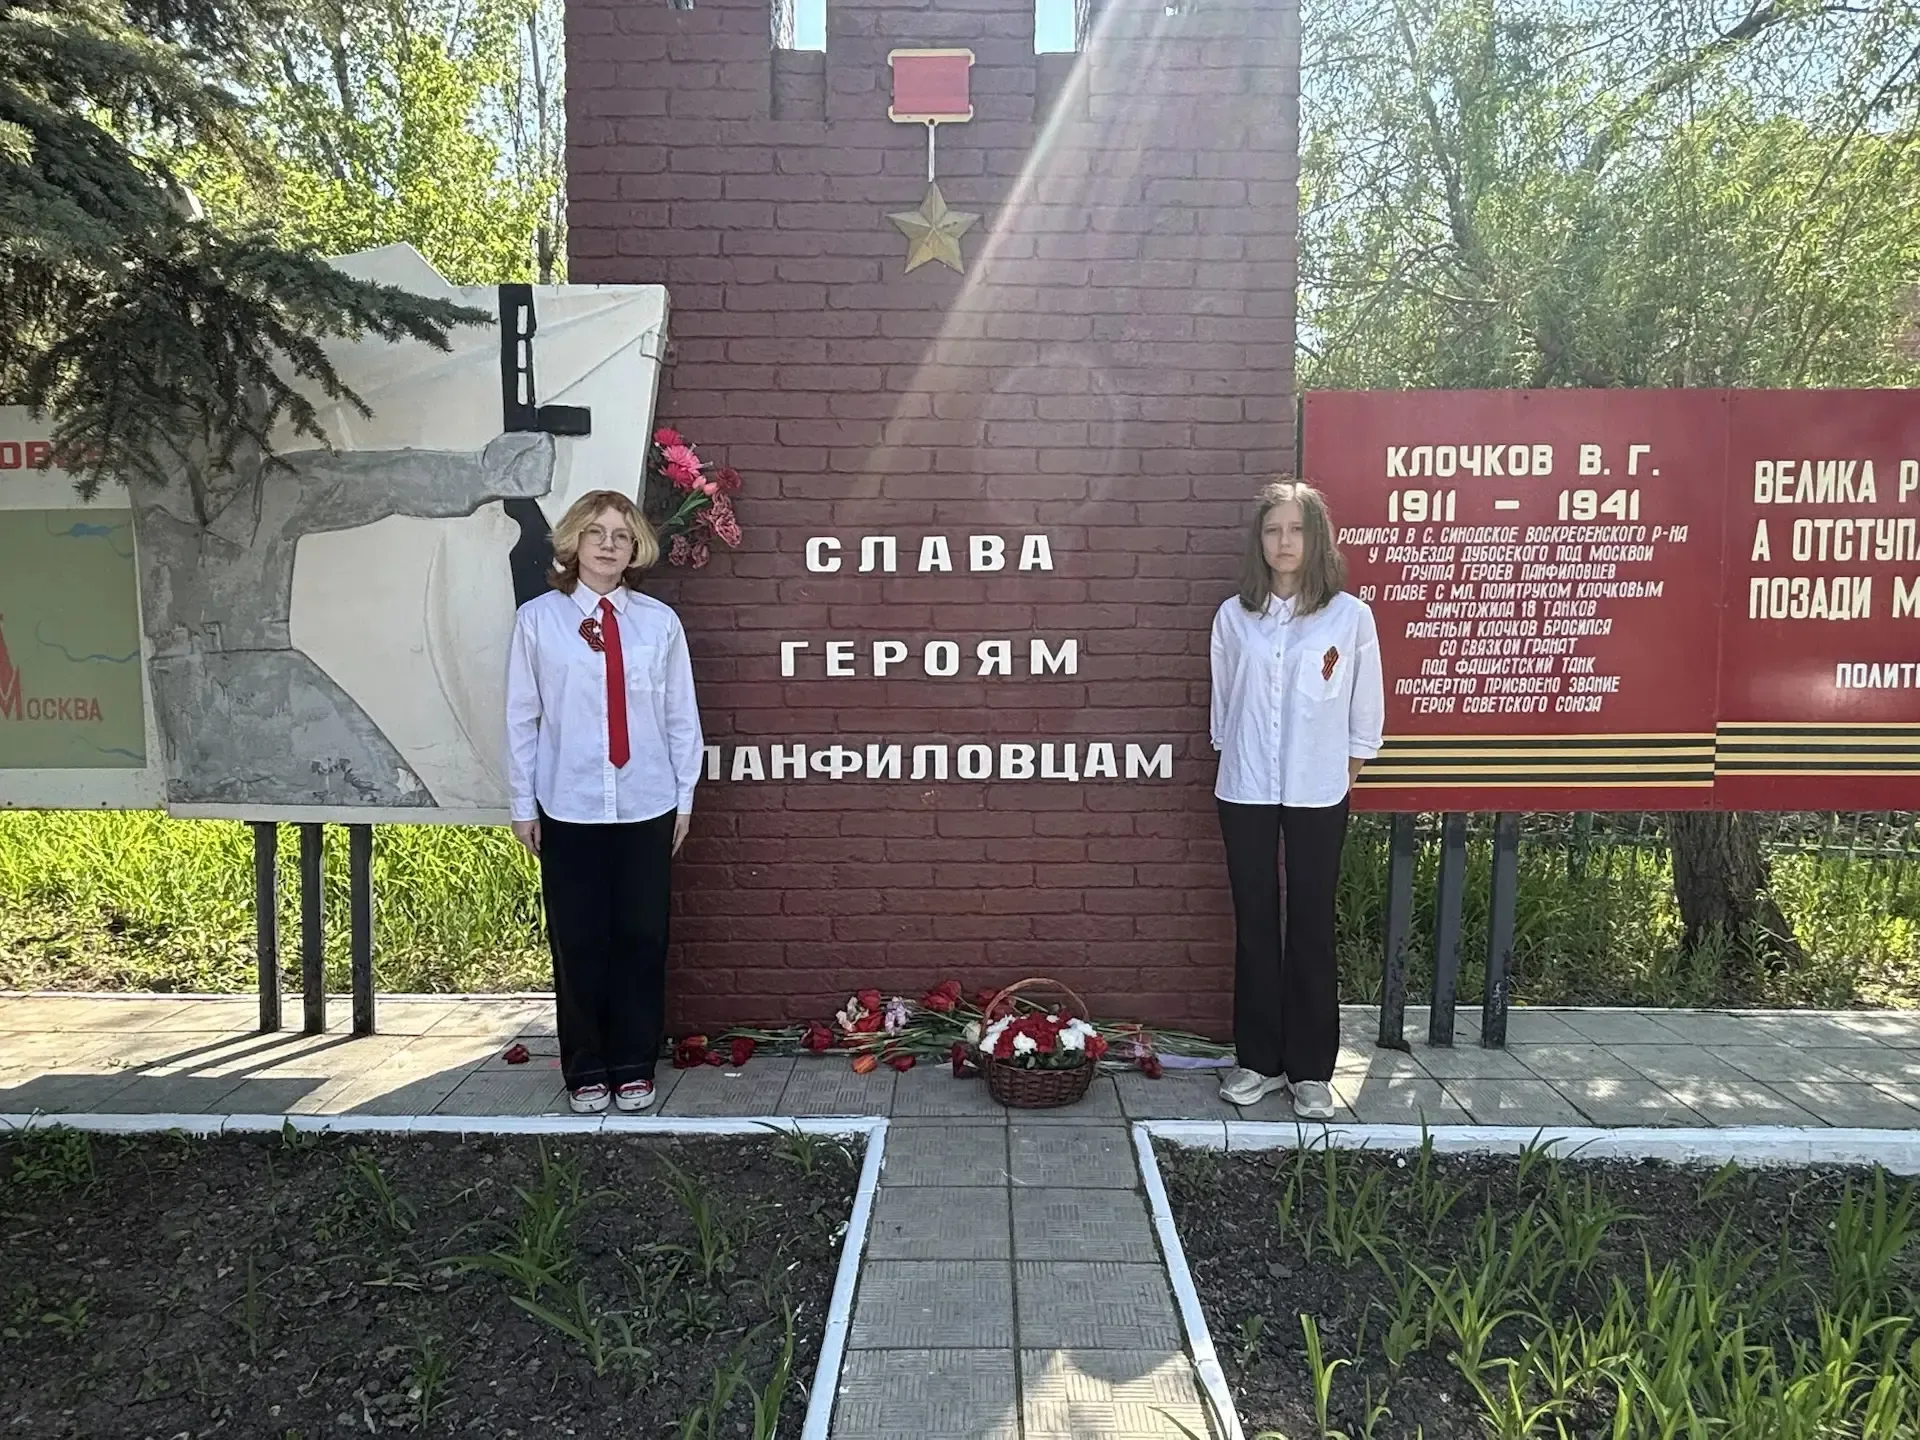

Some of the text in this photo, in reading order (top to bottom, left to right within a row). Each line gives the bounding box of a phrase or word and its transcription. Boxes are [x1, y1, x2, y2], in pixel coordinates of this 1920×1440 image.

[1387, 444, 1660, 477] КЛОЧКОВ В. Г.
[1754, 460, 1877, 503] ВЕЛИКА
[1388, 490, 1456, 523] 1911
[1558, 489, 1640, 521] 1941
[1337, 525, 1688, 545] РОДИЛСЯ В С. СИНОДСКОЕ ВОСКРЕСЕНСКОГО Р-НА
[1751, 518, 1920, 562] А ОТСТУП
[805, 535, 1054, 572] СЛАВА
[1368, 546, 1378, 563] У
[1460, 545, 1548, 563] ДУБОСЕКОГО
[1555, 545, 1582, 563] ПОД
[1401, 563, 1616, 581] ГРУППА ГЕРОЕВ ПАНФИЛОВЦЕВ
[1359, 581, 1664, 601] ВО ГЛАВЕ С МЛ. ПОЛИТРУКОМ КЛОЧКОВЫМ
[1749, 576, 1872, 621] ПОЗАДИ
[1425, 600, 1597, 619] УНИЧТОЖИЛА 18 ТАНКОВ
[1477, 619, 1538, 637] КЛОЧКОВ
[1543, 619, 1612, 636] БРОСИЛСЯ
[1439, 640, 1457, 656] СО
[1523, 637, 1578, 655] ГРАНАТ
[780, 639, 1078, 677] ГЕРОЯМ
[1421, 655, 1596, 676] ПОД ФАШИСТСКИЙ ТАНК
[1395, 675, 1621, 695] ПОСМЕРТНО ПРИСВОЕНО ЗВАНИЕ
[1411, 695, 1602, 713] ГЕРОЯ СОВЕТСКОГО СОЮЗА
